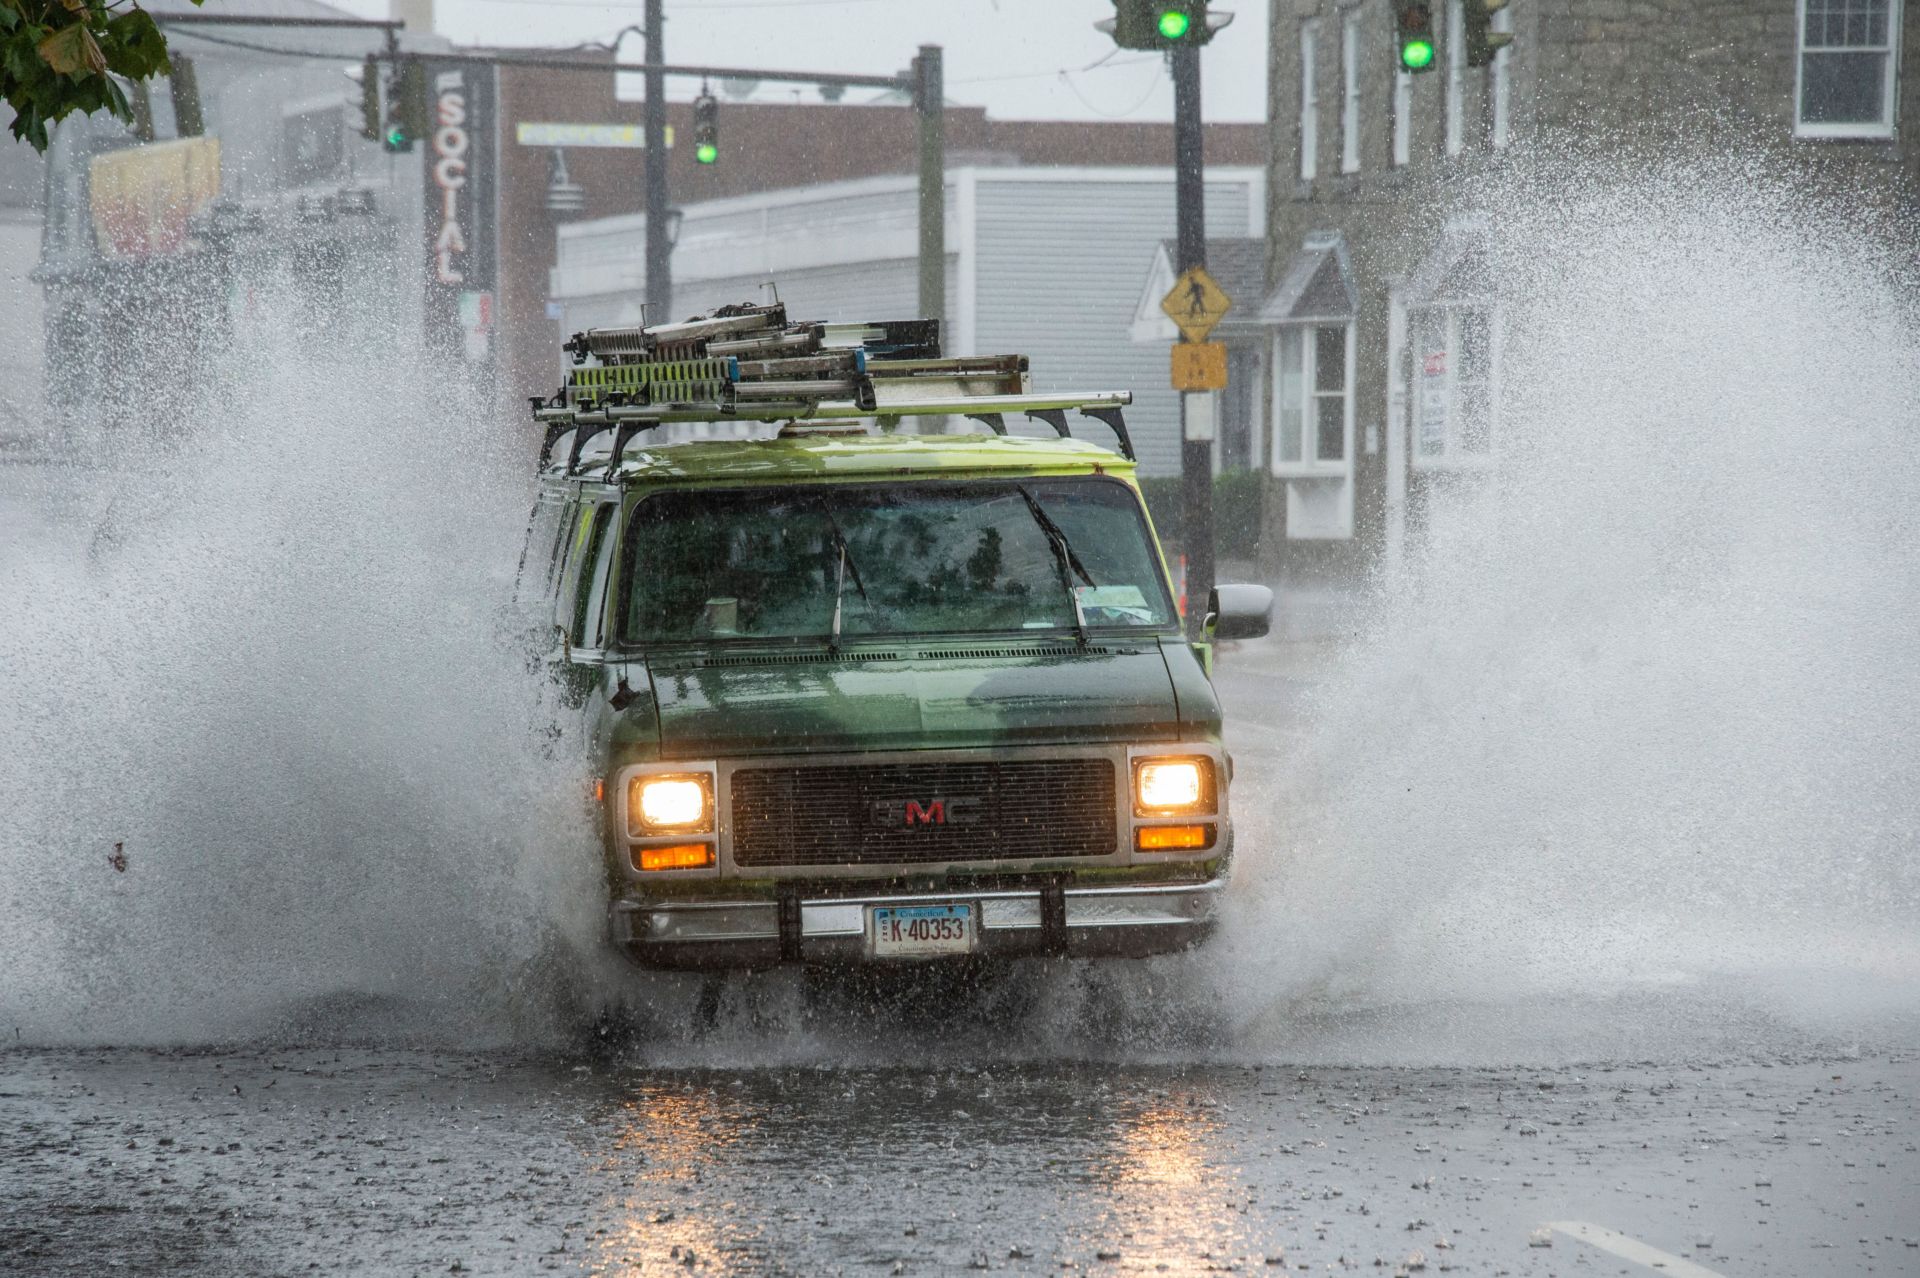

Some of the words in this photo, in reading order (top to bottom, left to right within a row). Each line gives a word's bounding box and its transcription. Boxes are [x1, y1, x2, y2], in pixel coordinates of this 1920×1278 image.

[434, 92, 468, 283] SOCIAL
[870, 797, 981, 825] GMC
[900, 910, 944, 918] Connecticut
